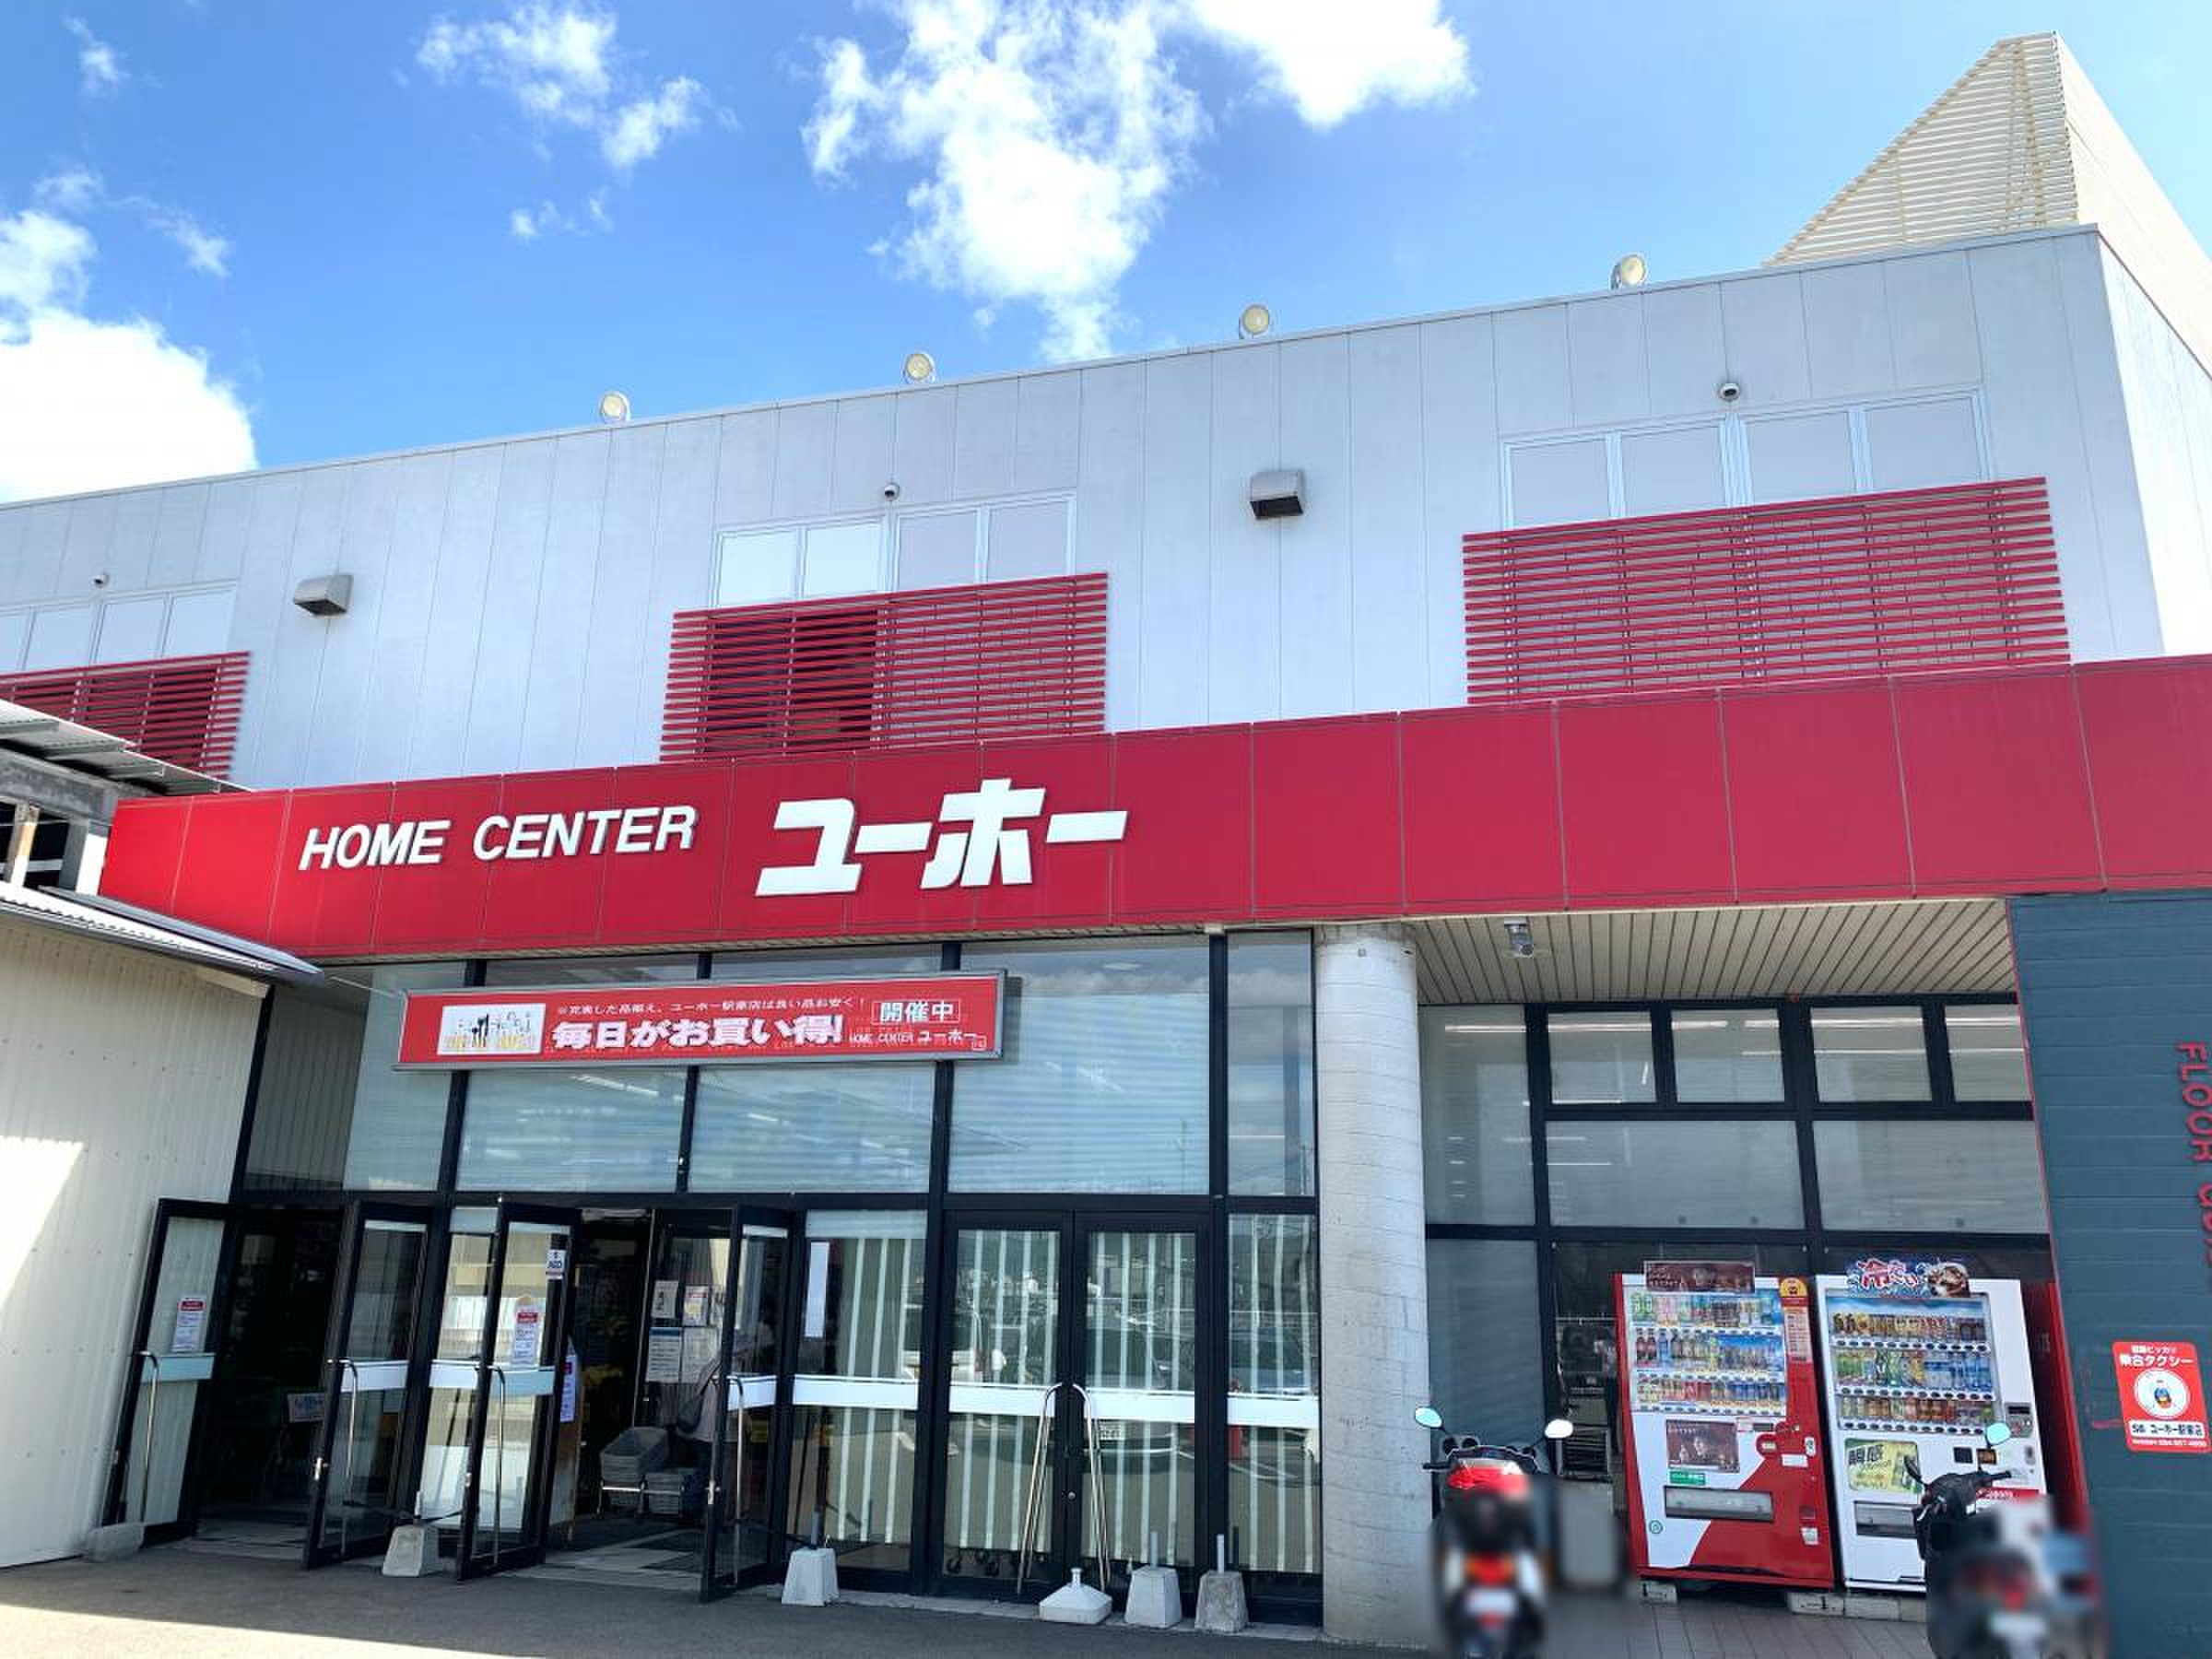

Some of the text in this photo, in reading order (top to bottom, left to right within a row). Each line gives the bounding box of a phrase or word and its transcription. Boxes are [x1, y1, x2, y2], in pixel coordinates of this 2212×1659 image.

[298, 778, 1128, 896] HOME CENTER ユーホー
[879, 1000, 954, 1023] 開催中
[552, 1015, 843, 1049] 毎日がお買い得!
[917, 1029, 977, 1043] ユーホー
